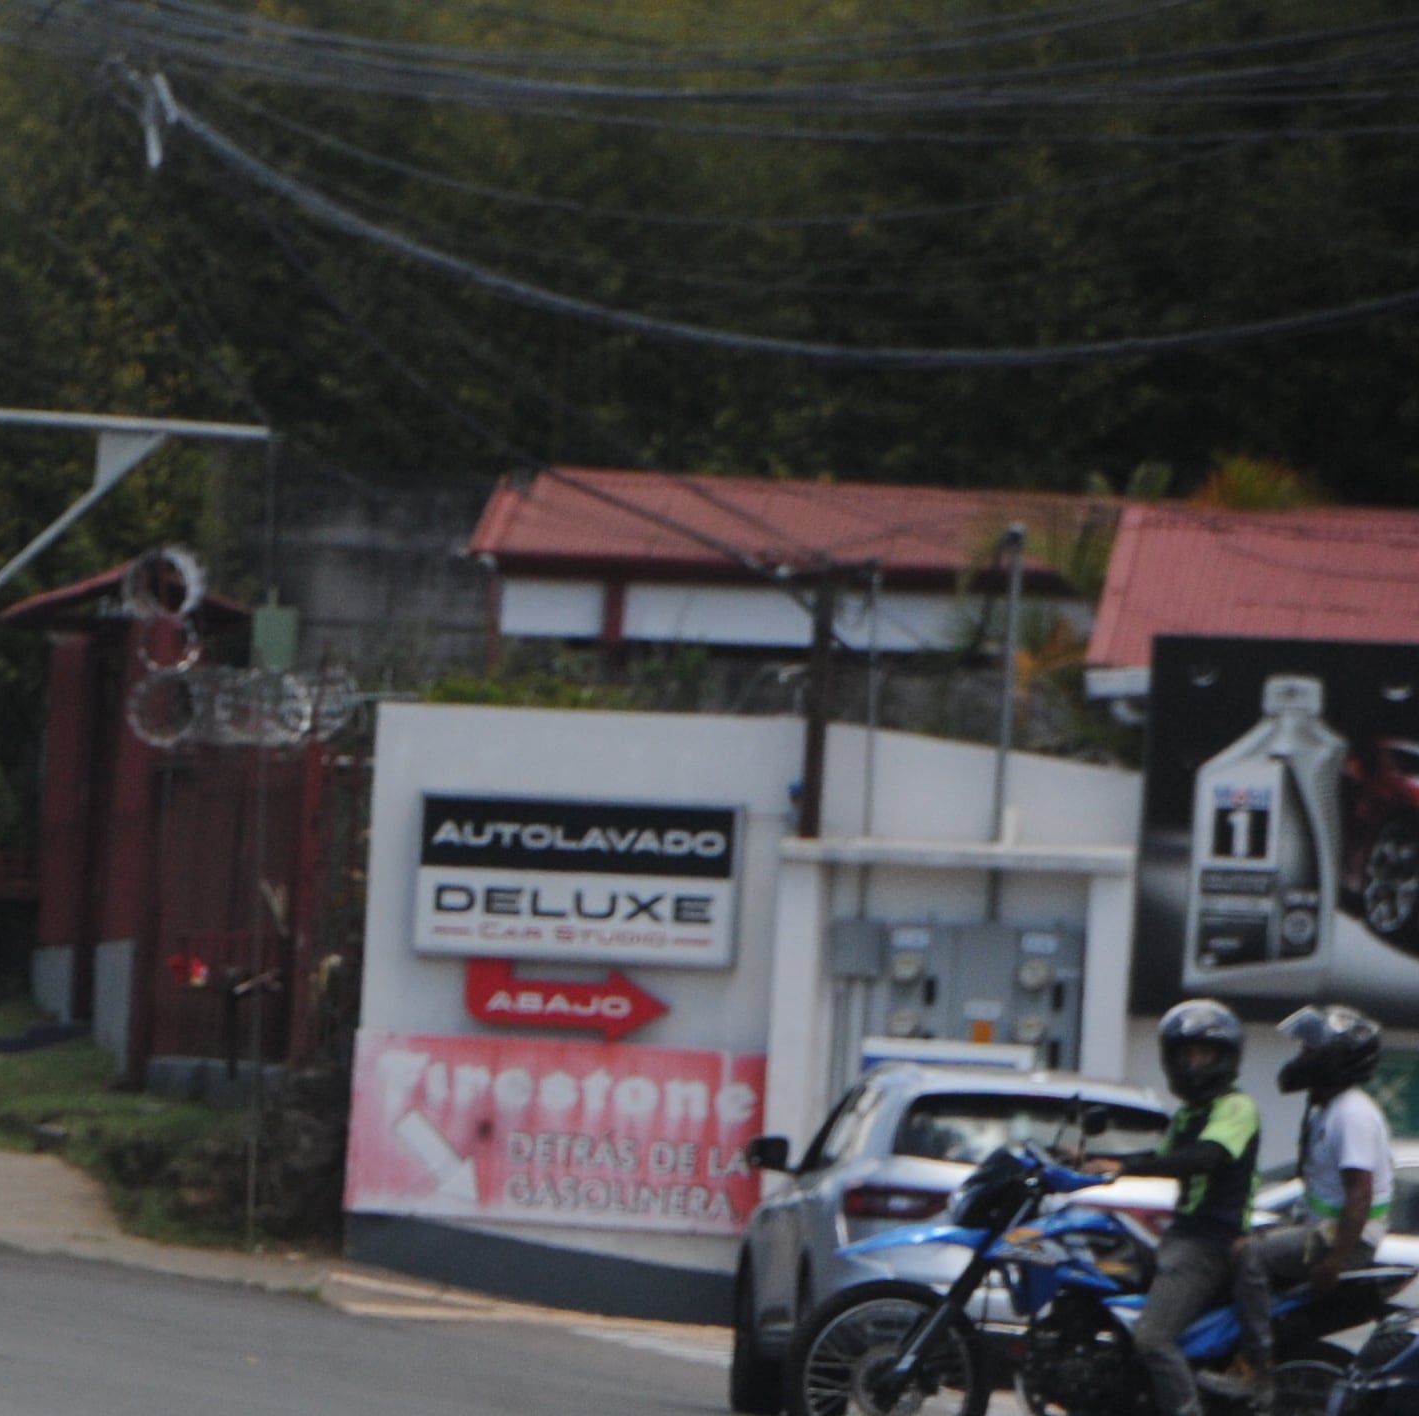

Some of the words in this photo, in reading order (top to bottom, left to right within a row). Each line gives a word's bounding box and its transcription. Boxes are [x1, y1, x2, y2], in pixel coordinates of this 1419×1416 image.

[431, 819, 727, 858] AUTOLAVADO
[433, 884, 715, 924] DELUXE
[485, 990, 633, 1018] ABAJO
[377, 1049, 757, 1124] Firestone
[507, 1129, 639, 1173] DETRÁS
[649, 1141, 698, 1177] DE
[707, 1145, 752, 1179] LA
